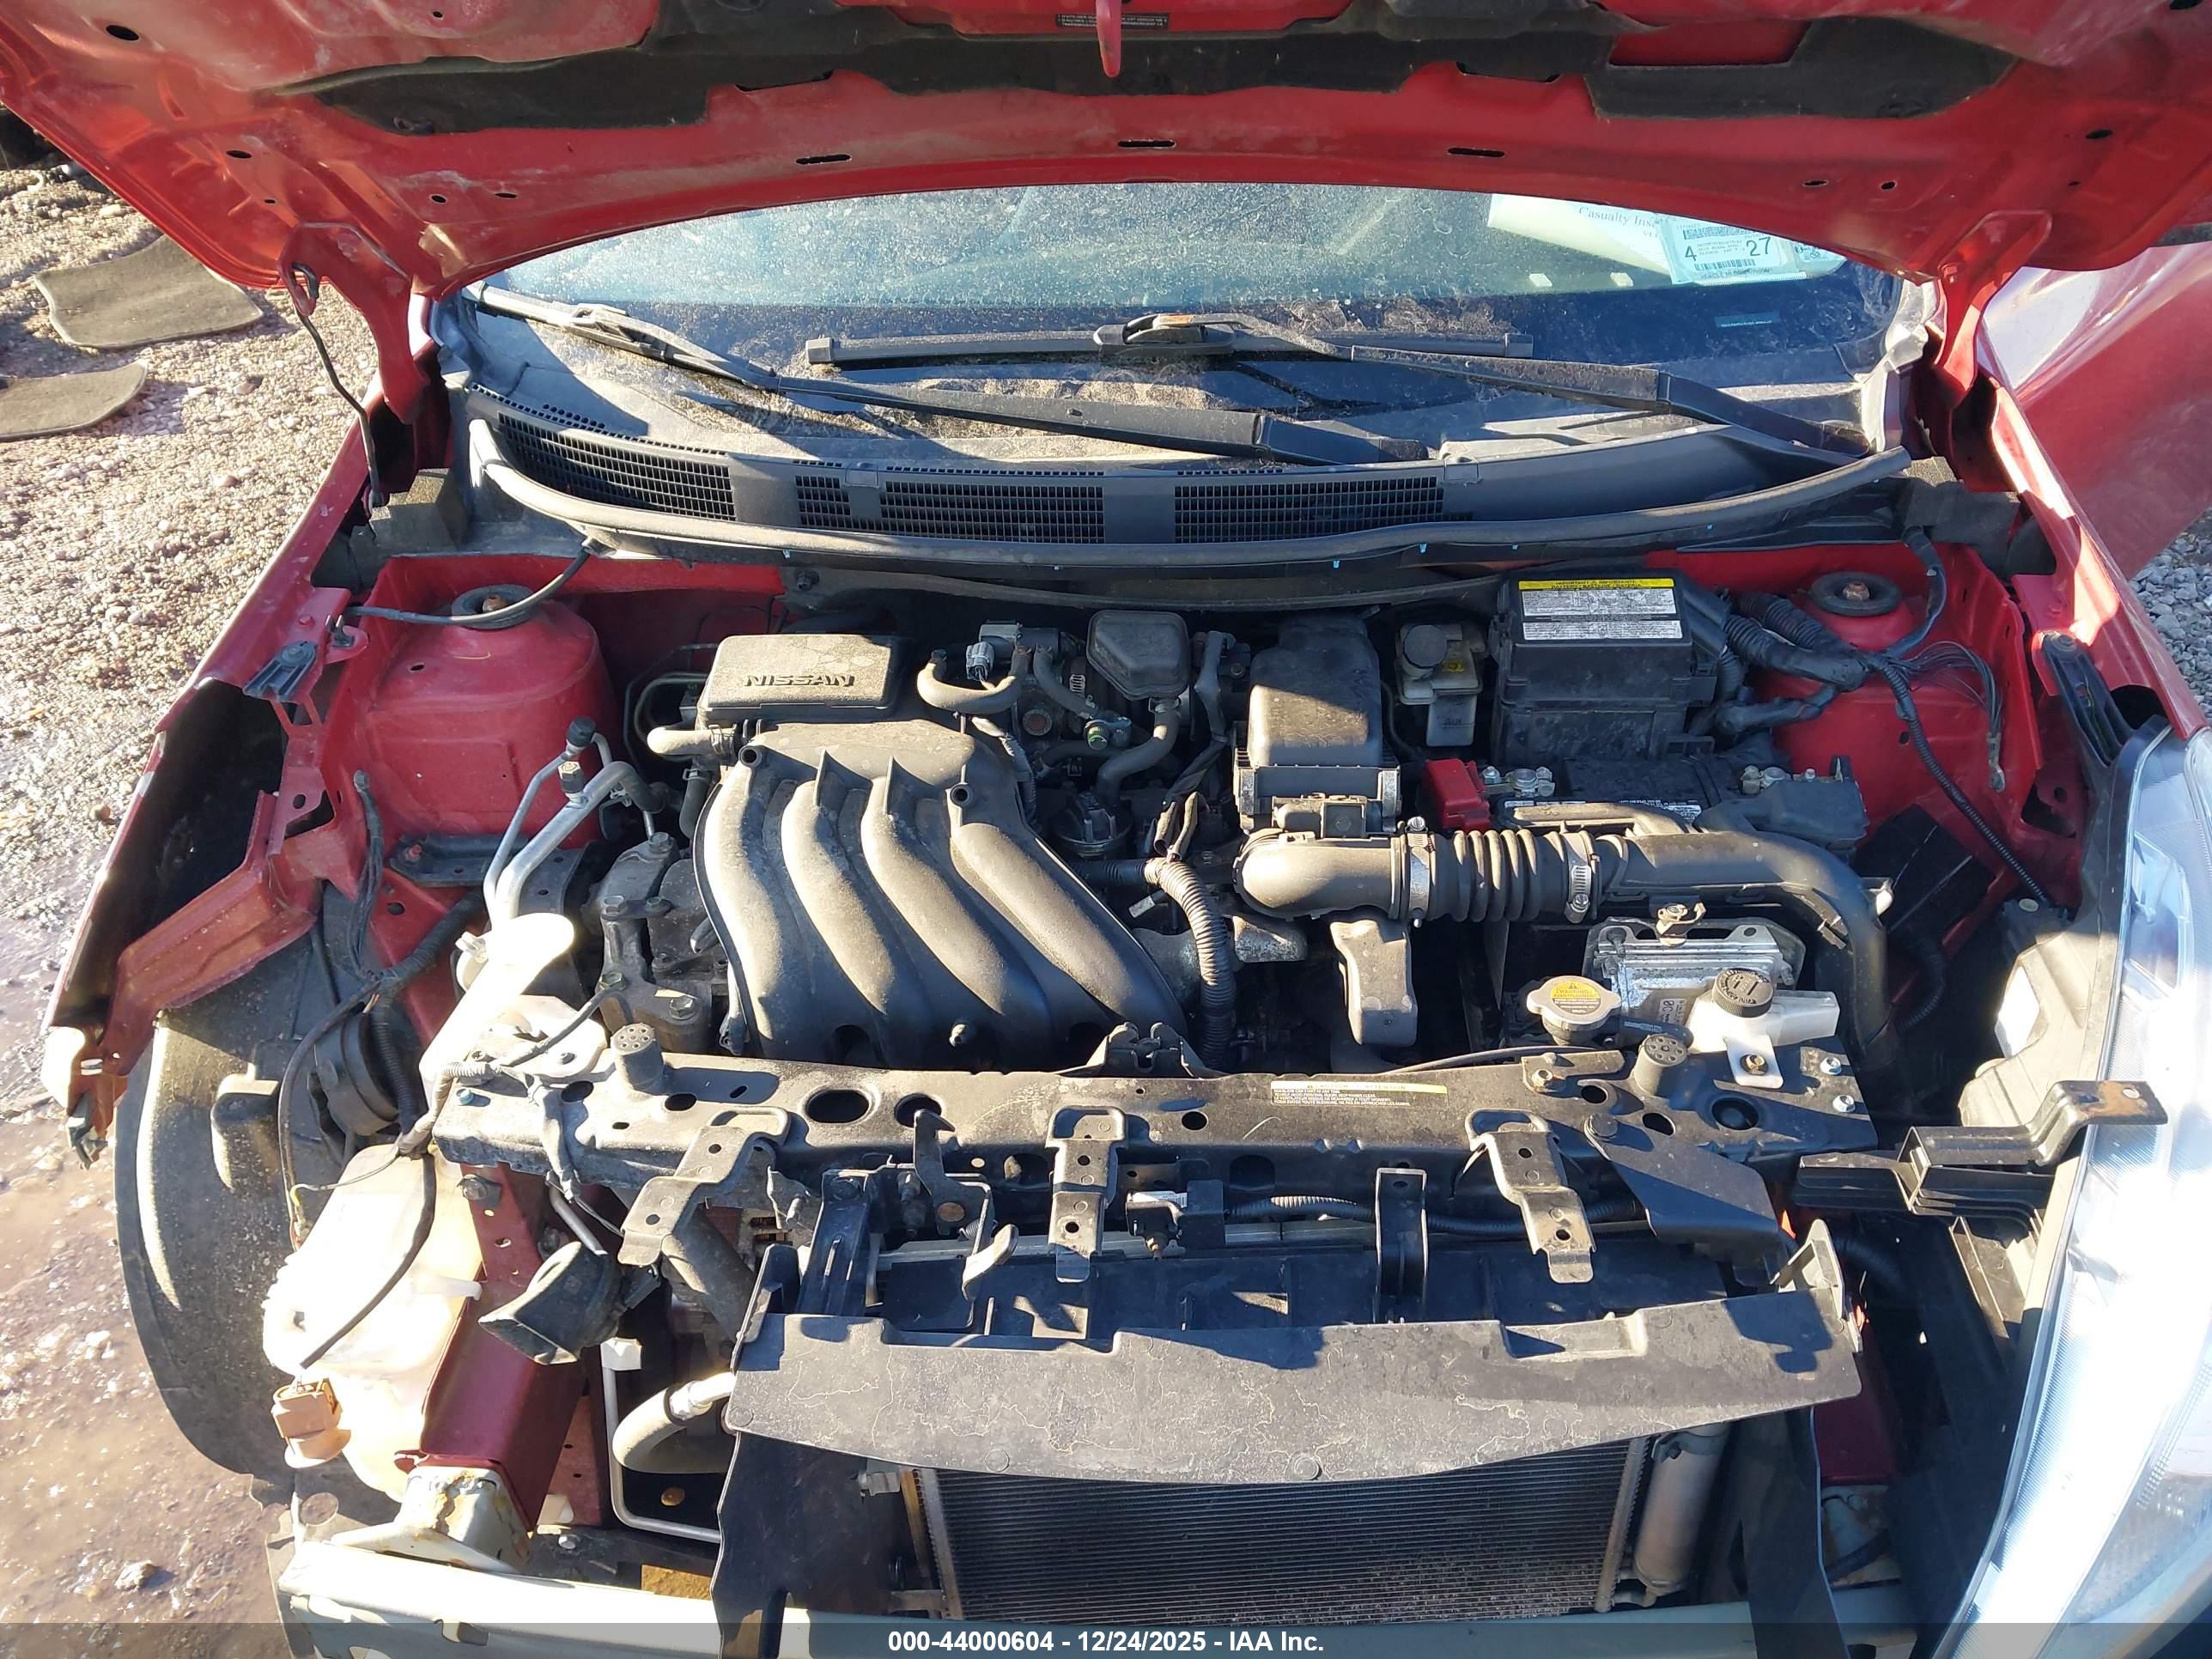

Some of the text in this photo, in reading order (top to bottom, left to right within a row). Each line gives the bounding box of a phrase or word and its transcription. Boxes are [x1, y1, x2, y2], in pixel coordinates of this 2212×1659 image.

[1579, 206, 1630, 226] Casualty
[1685, 246, 1698, 262] 4
[1747, 236, 1771, 257] 27
[743, 674, 855, 688] NISSAN
